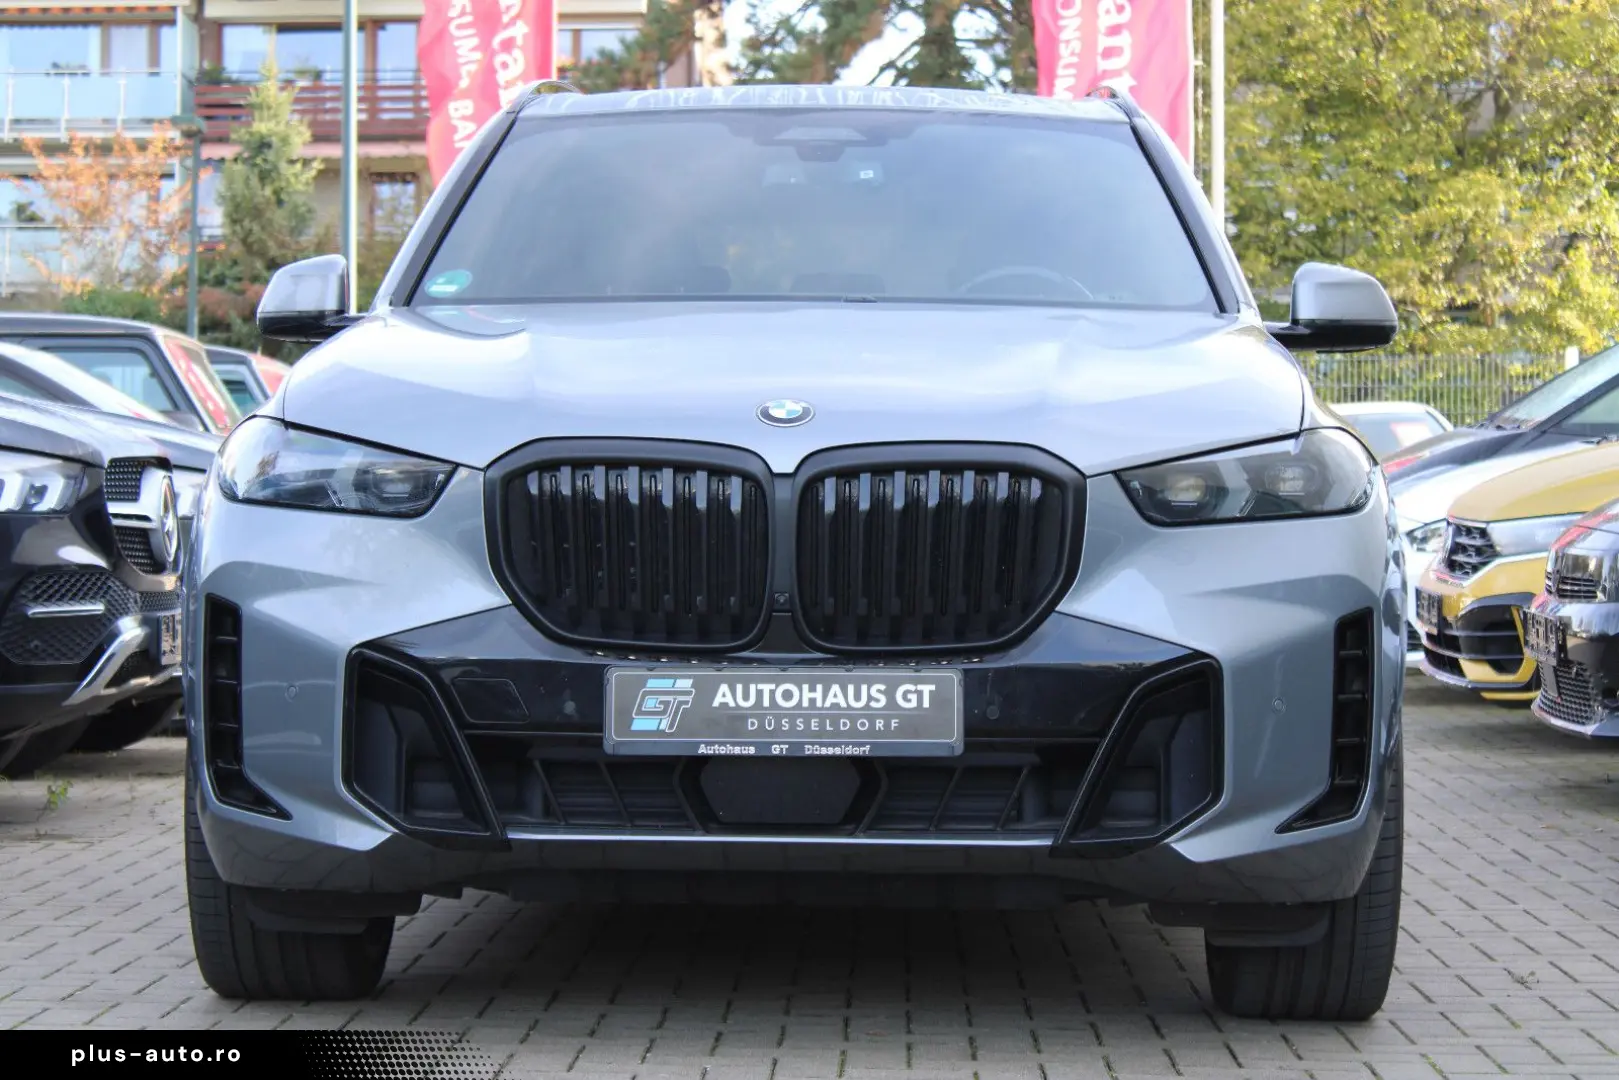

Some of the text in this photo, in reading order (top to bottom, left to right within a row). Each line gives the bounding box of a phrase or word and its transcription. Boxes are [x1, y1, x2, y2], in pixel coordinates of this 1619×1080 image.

[712, 683, 936, 708] AUTOHAUS GT
[748, 716, 901, 731] DÜSSELDORF
[698, 744, 871, 755] Autohaus GT Düsseldorf
